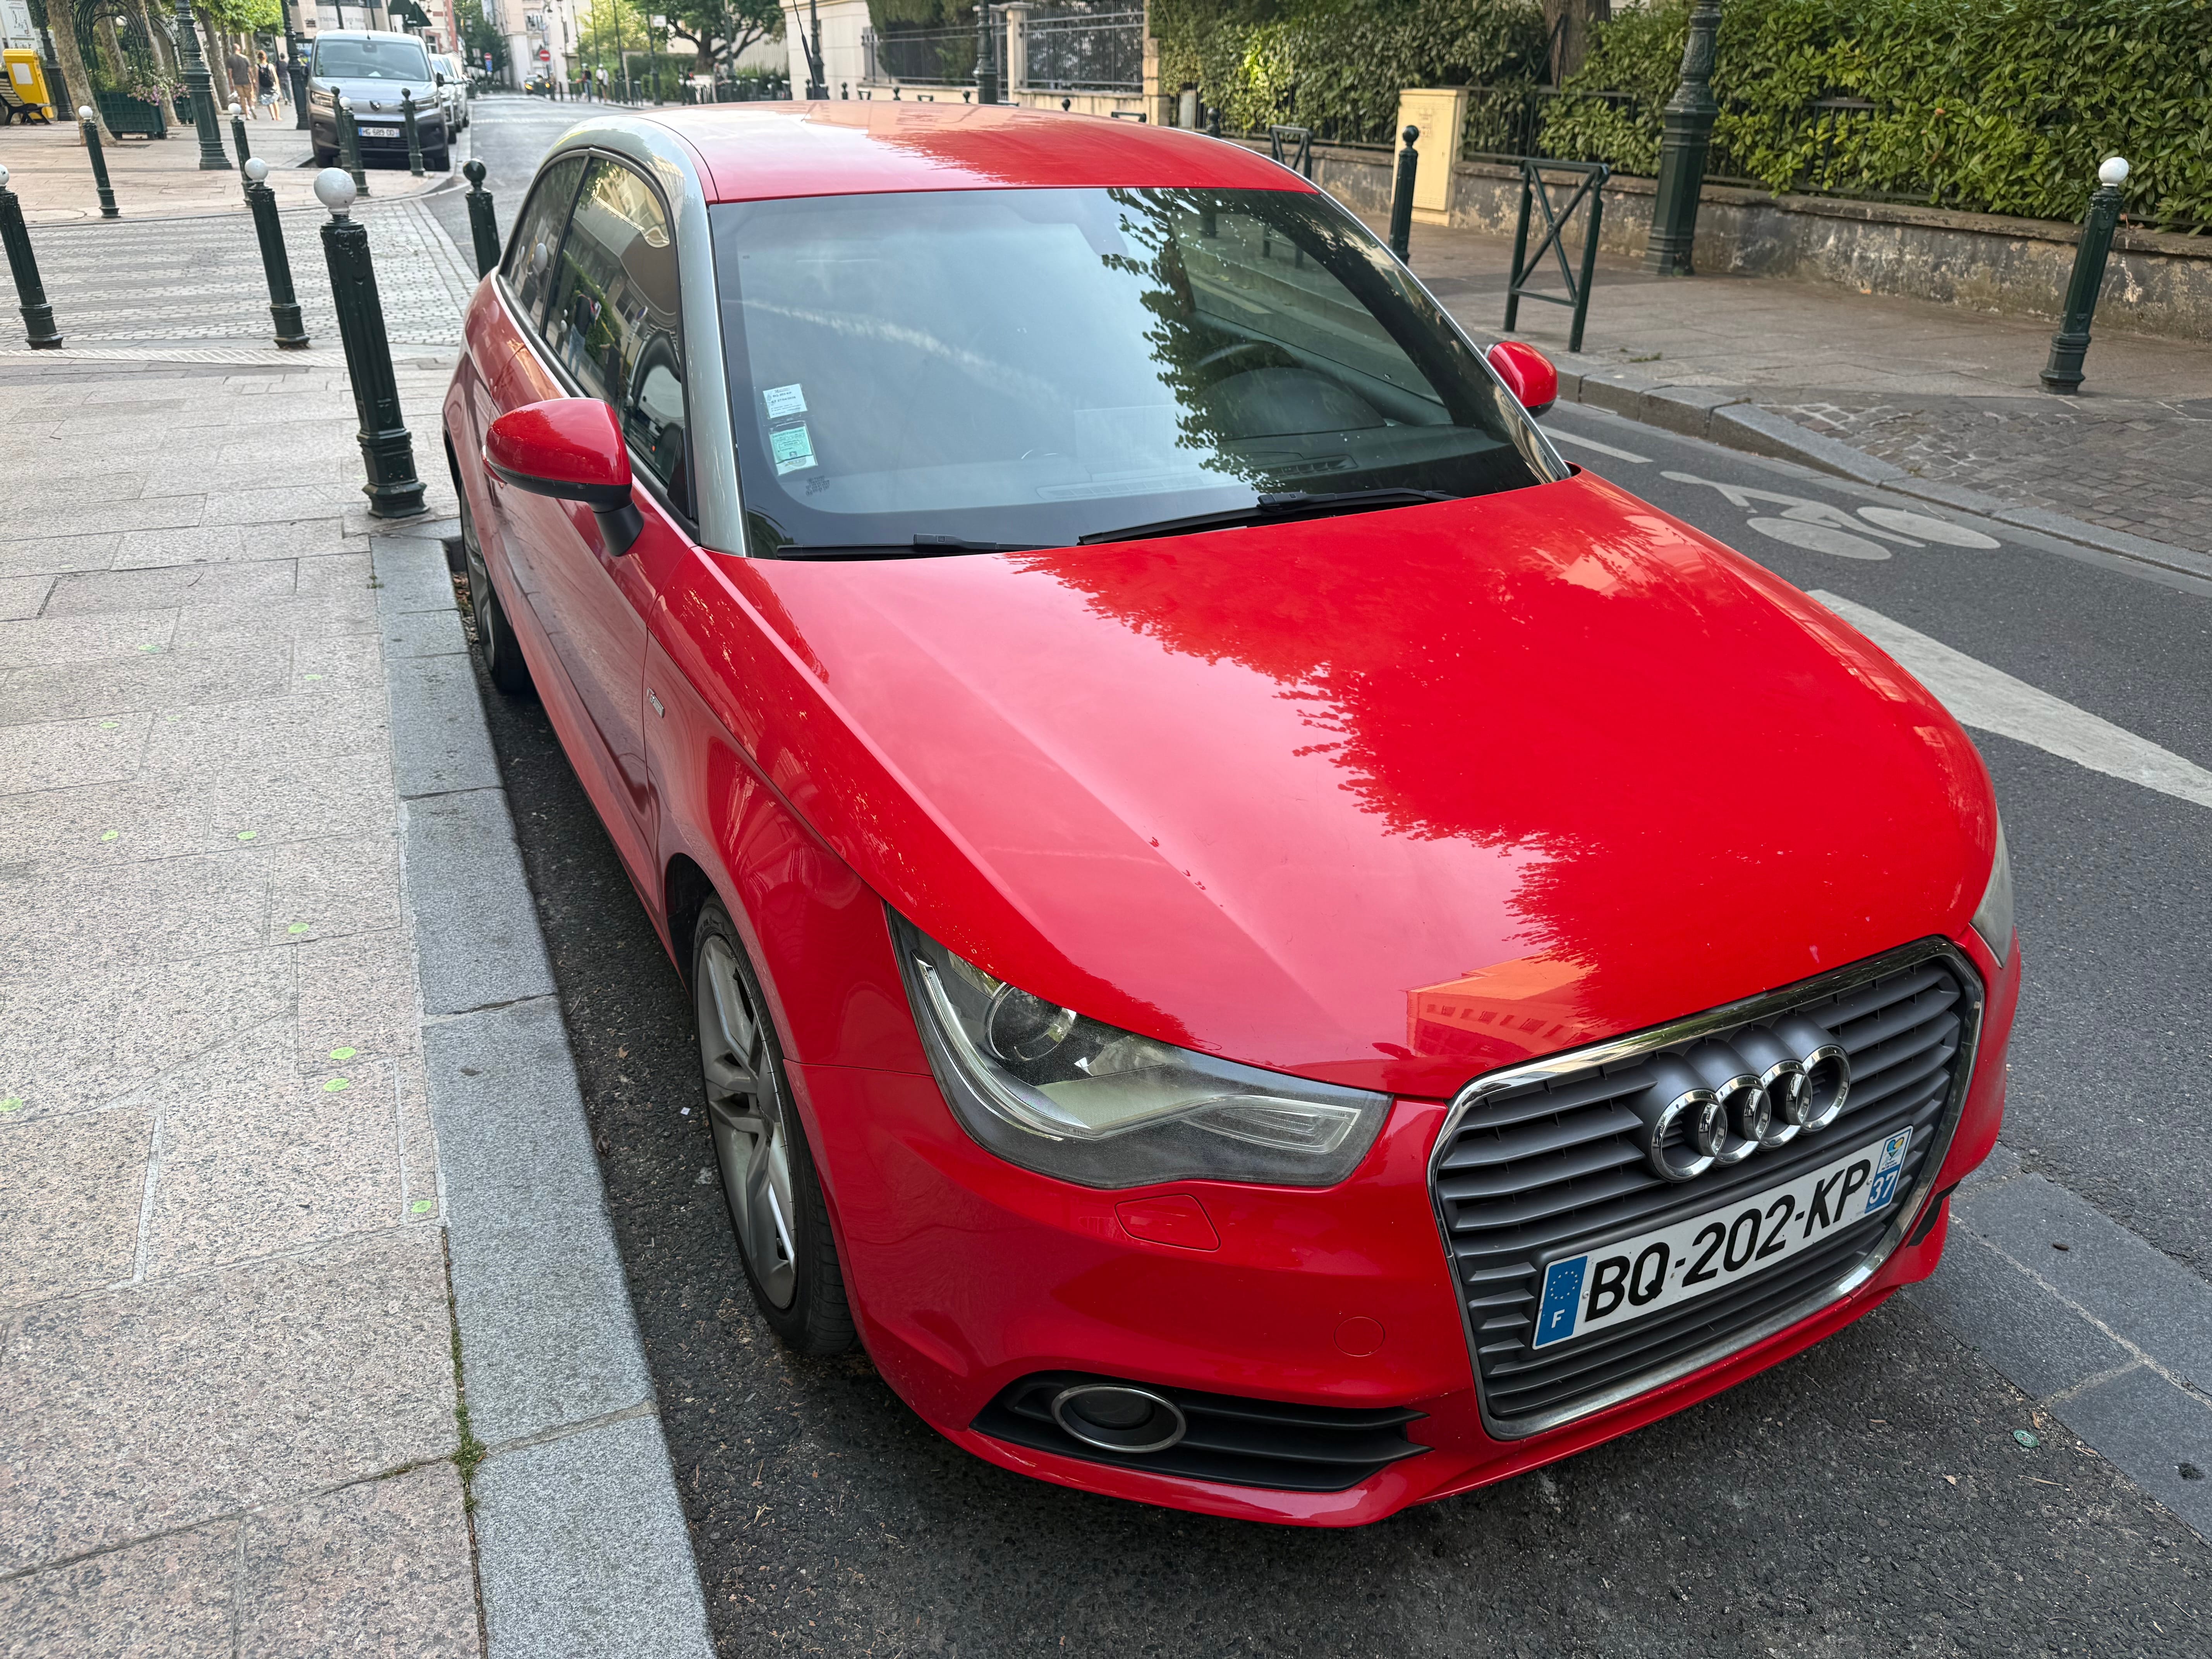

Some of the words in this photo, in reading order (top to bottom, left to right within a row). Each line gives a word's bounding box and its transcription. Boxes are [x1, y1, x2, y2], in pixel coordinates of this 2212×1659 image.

[732, 937, 776, 1052] BRIDGESTONE
[1869, 1170, 1898, 1204] 37
[1585, 1159, 1871, 1322] BQ-202-KP
[1551, 1309, 1565, 1328] F
